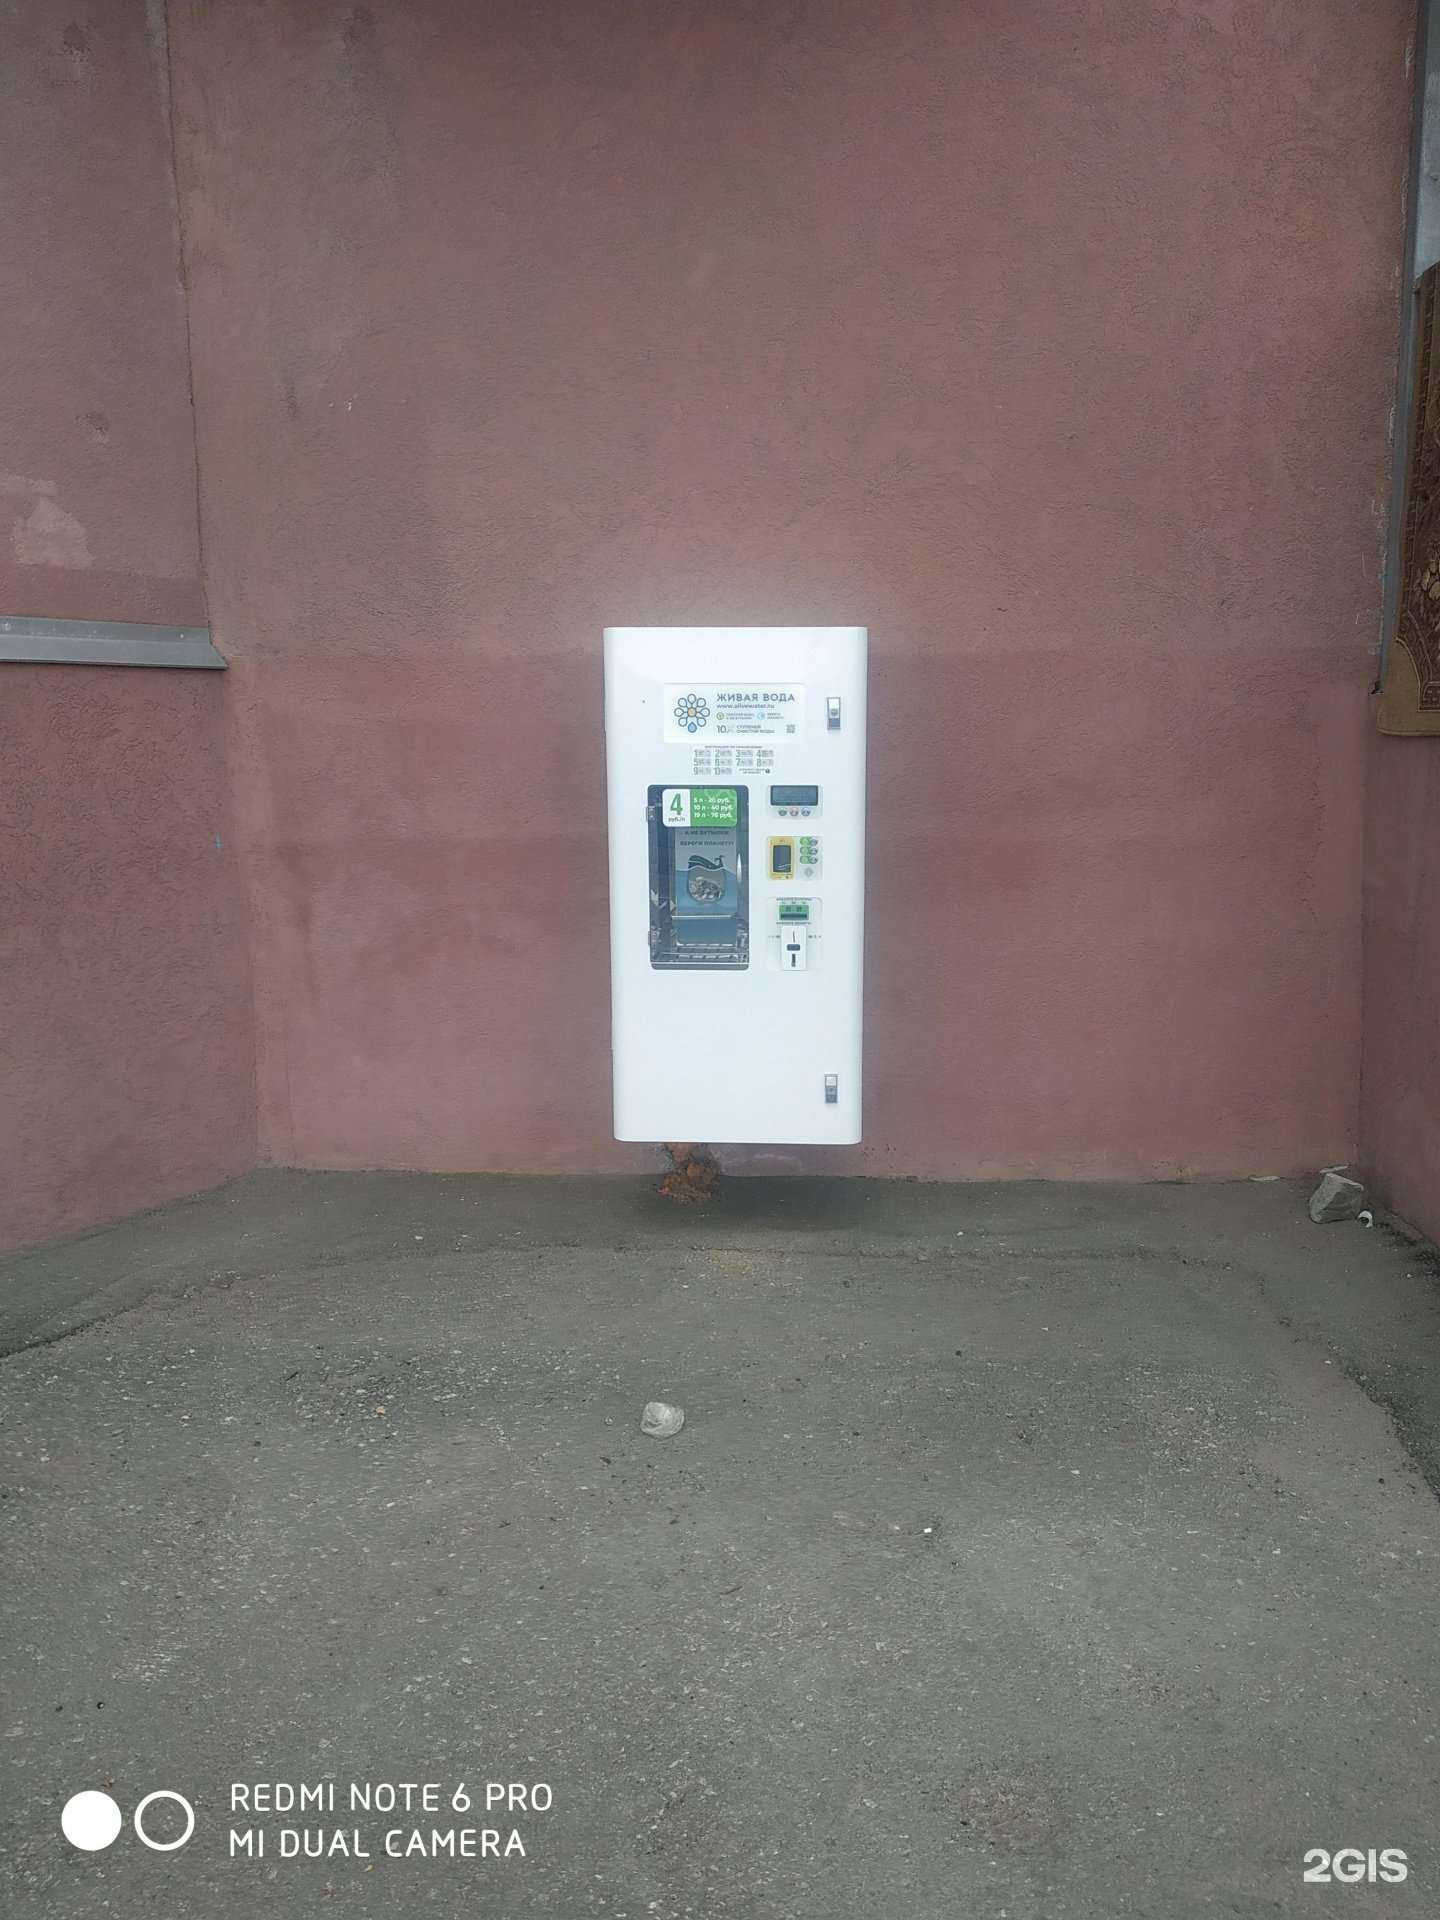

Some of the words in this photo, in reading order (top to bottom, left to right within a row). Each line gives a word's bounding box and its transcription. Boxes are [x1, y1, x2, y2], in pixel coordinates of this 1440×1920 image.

[716, 693, 759, 702] ЖИВАЯ
[762, 693, 795, 702] ВОДА
[670, 793, 683, 816] 4
